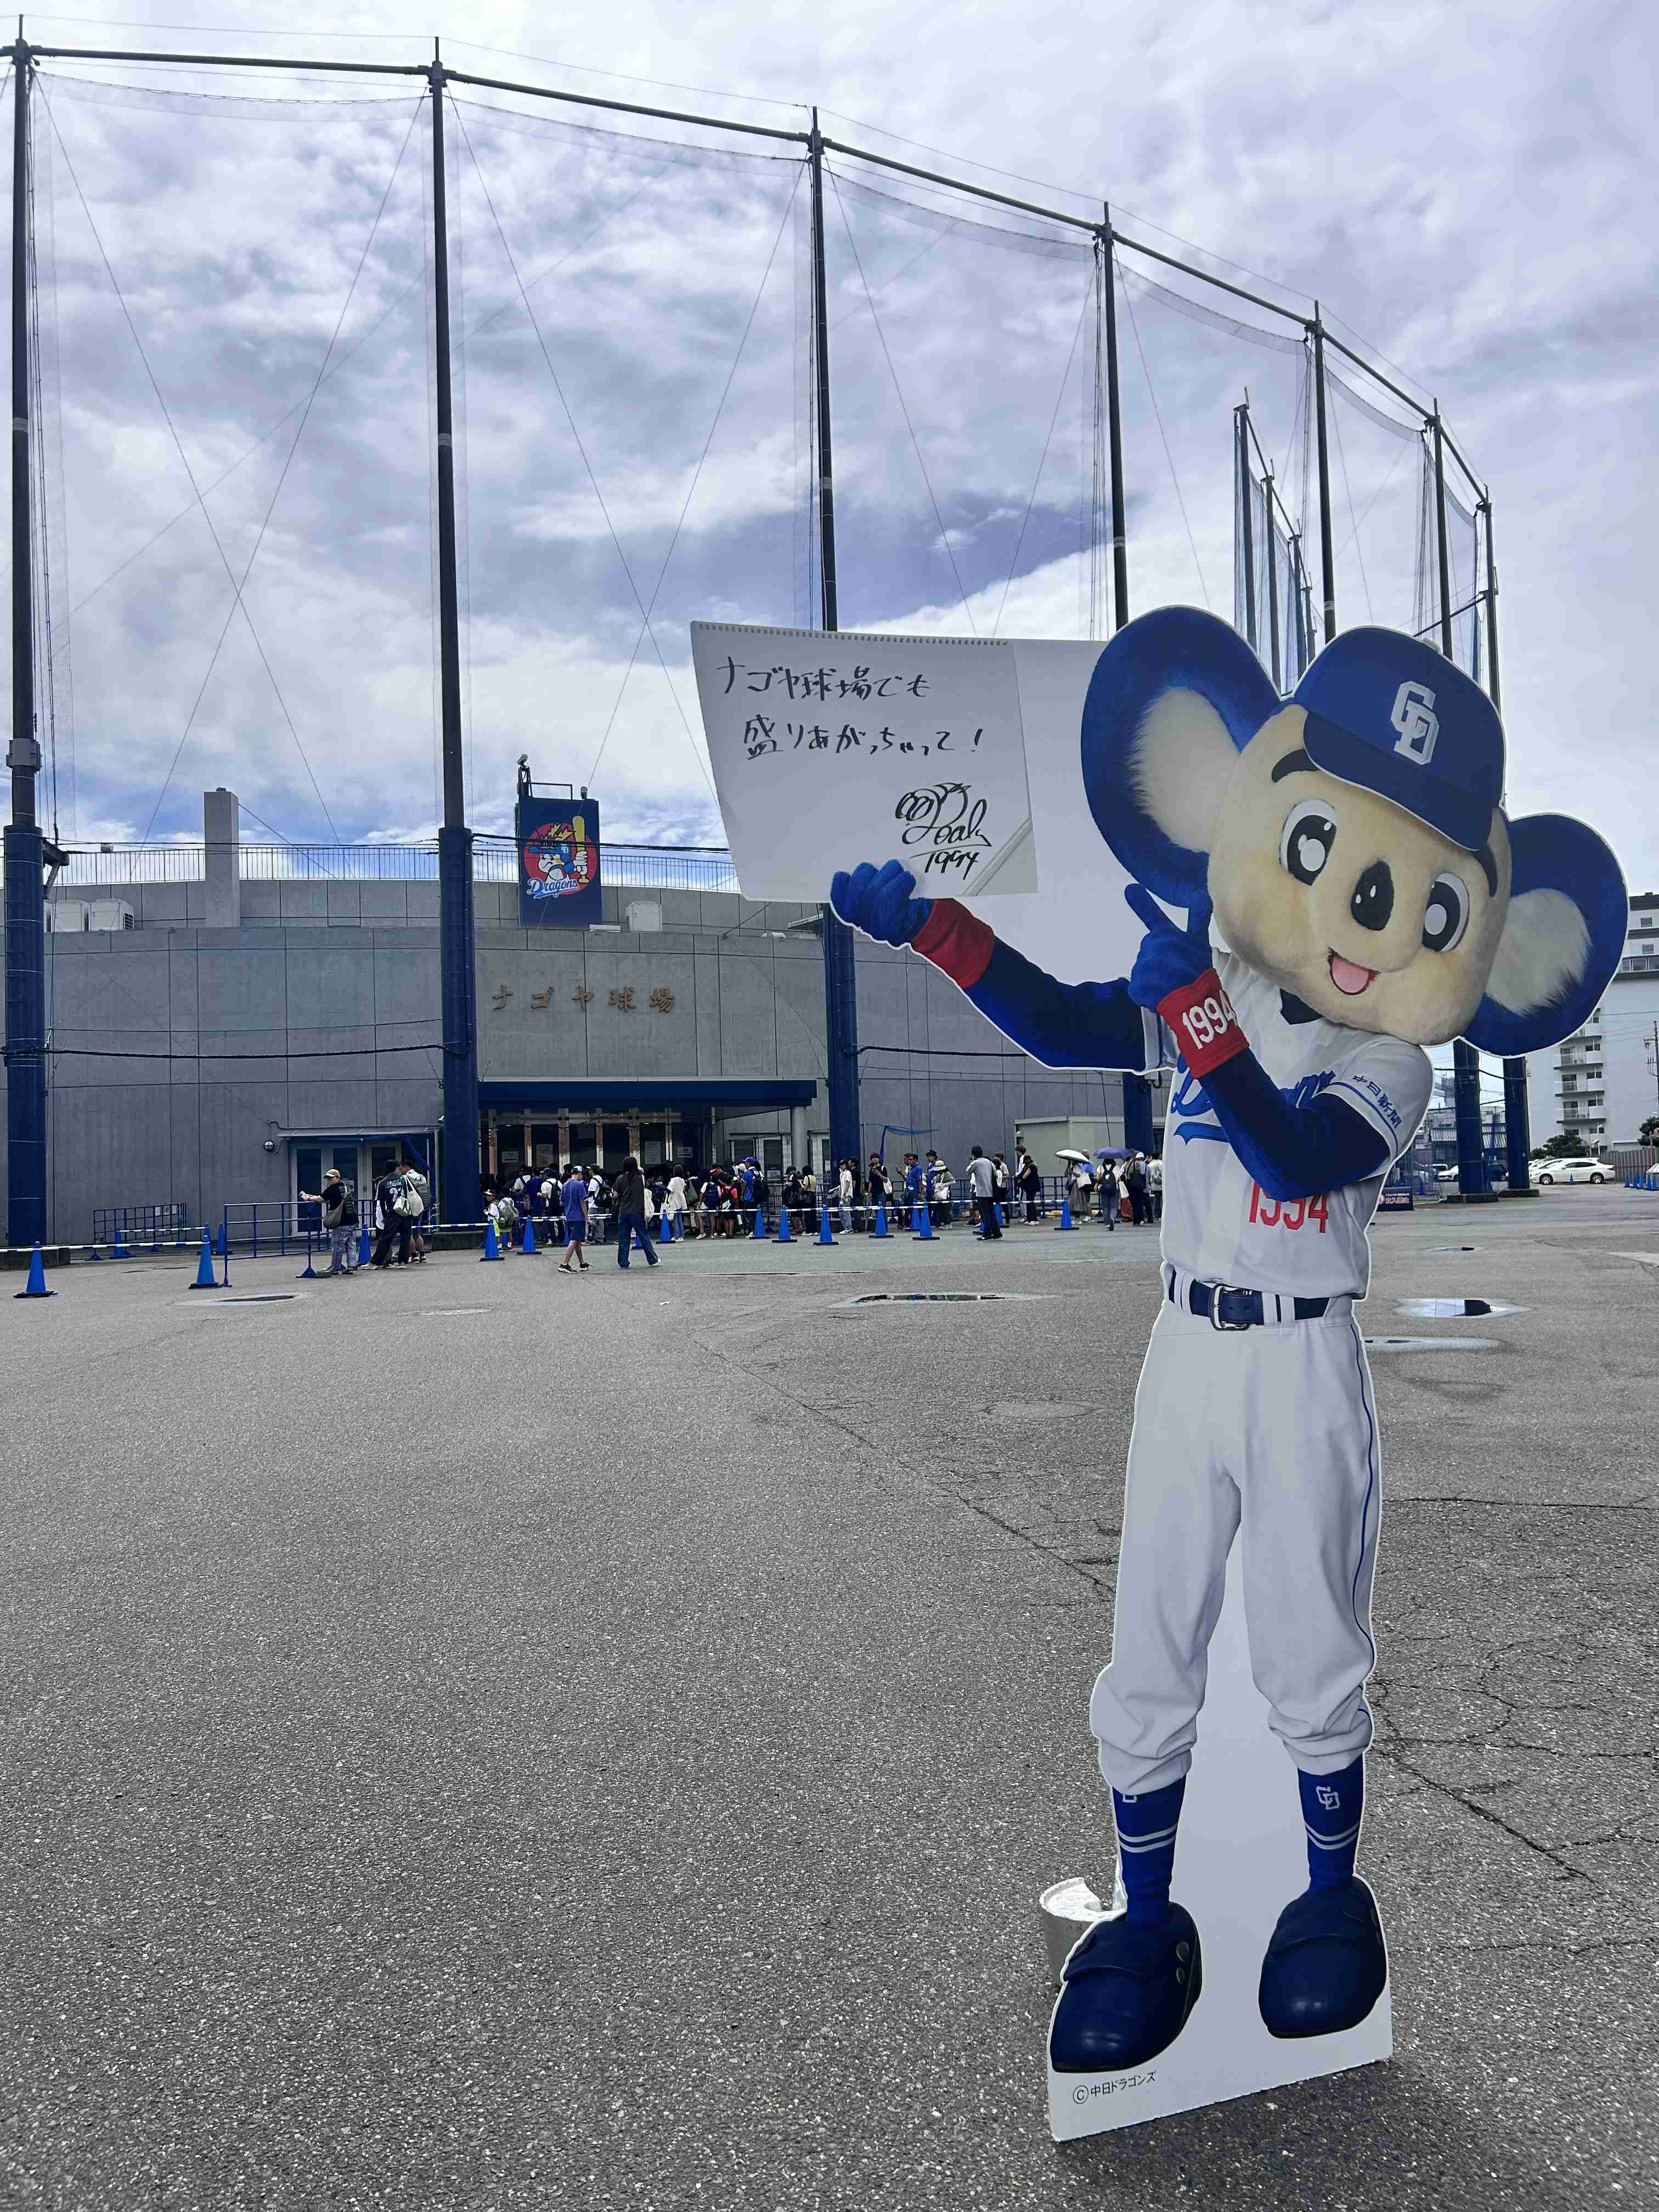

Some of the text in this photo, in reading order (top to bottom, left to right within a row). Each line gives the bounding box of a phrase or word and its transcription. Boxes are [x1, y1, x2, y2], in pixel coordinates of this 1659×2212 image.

[715, 656, 931, 701] ナゴヤ球場でも
[924, 850, 980, 881] 1994
[527, 877, 579, 899] Dragons
[492, 984, 675, 1013] ナゴヤ球場
[1182, 989, 1238, 1049] 1994
